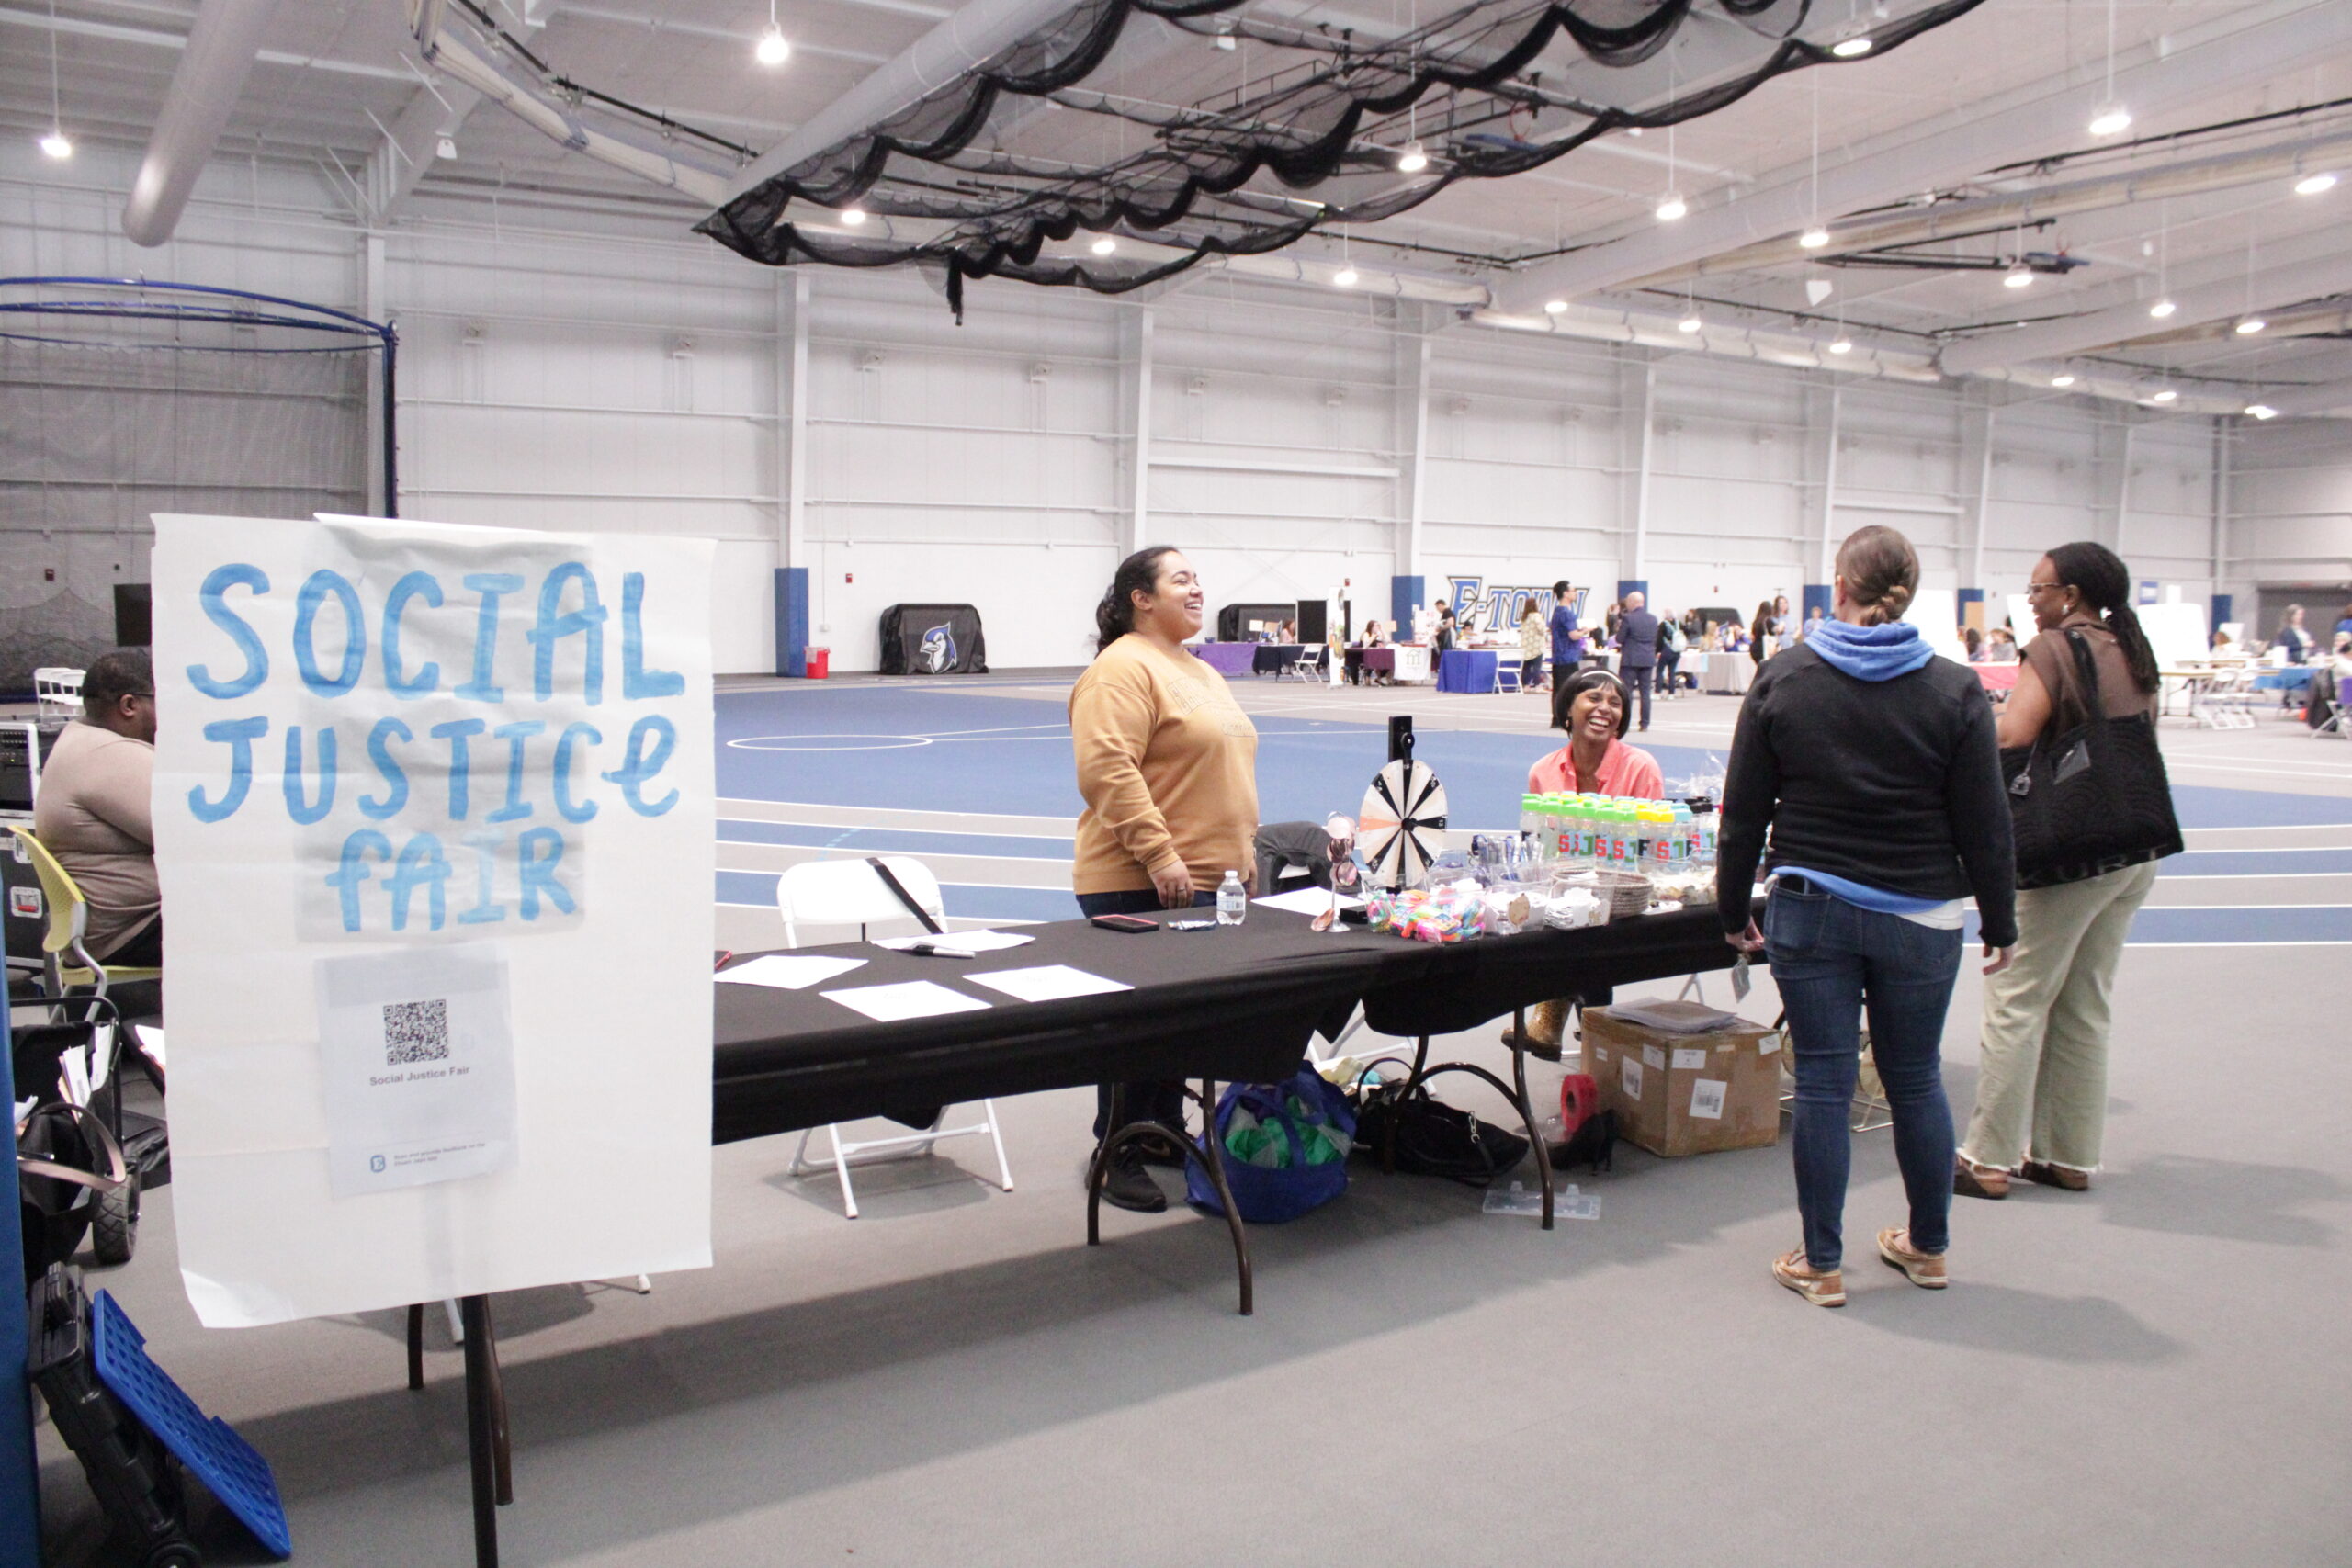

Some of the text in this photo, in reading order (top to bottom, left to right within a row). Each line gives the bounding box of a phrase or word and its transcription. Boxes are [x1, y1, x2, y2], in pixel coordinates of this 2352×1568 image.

[187, 561, 684, 705] SOCIAL
[369, 1066, 470, 1086] Social Justice Fair
